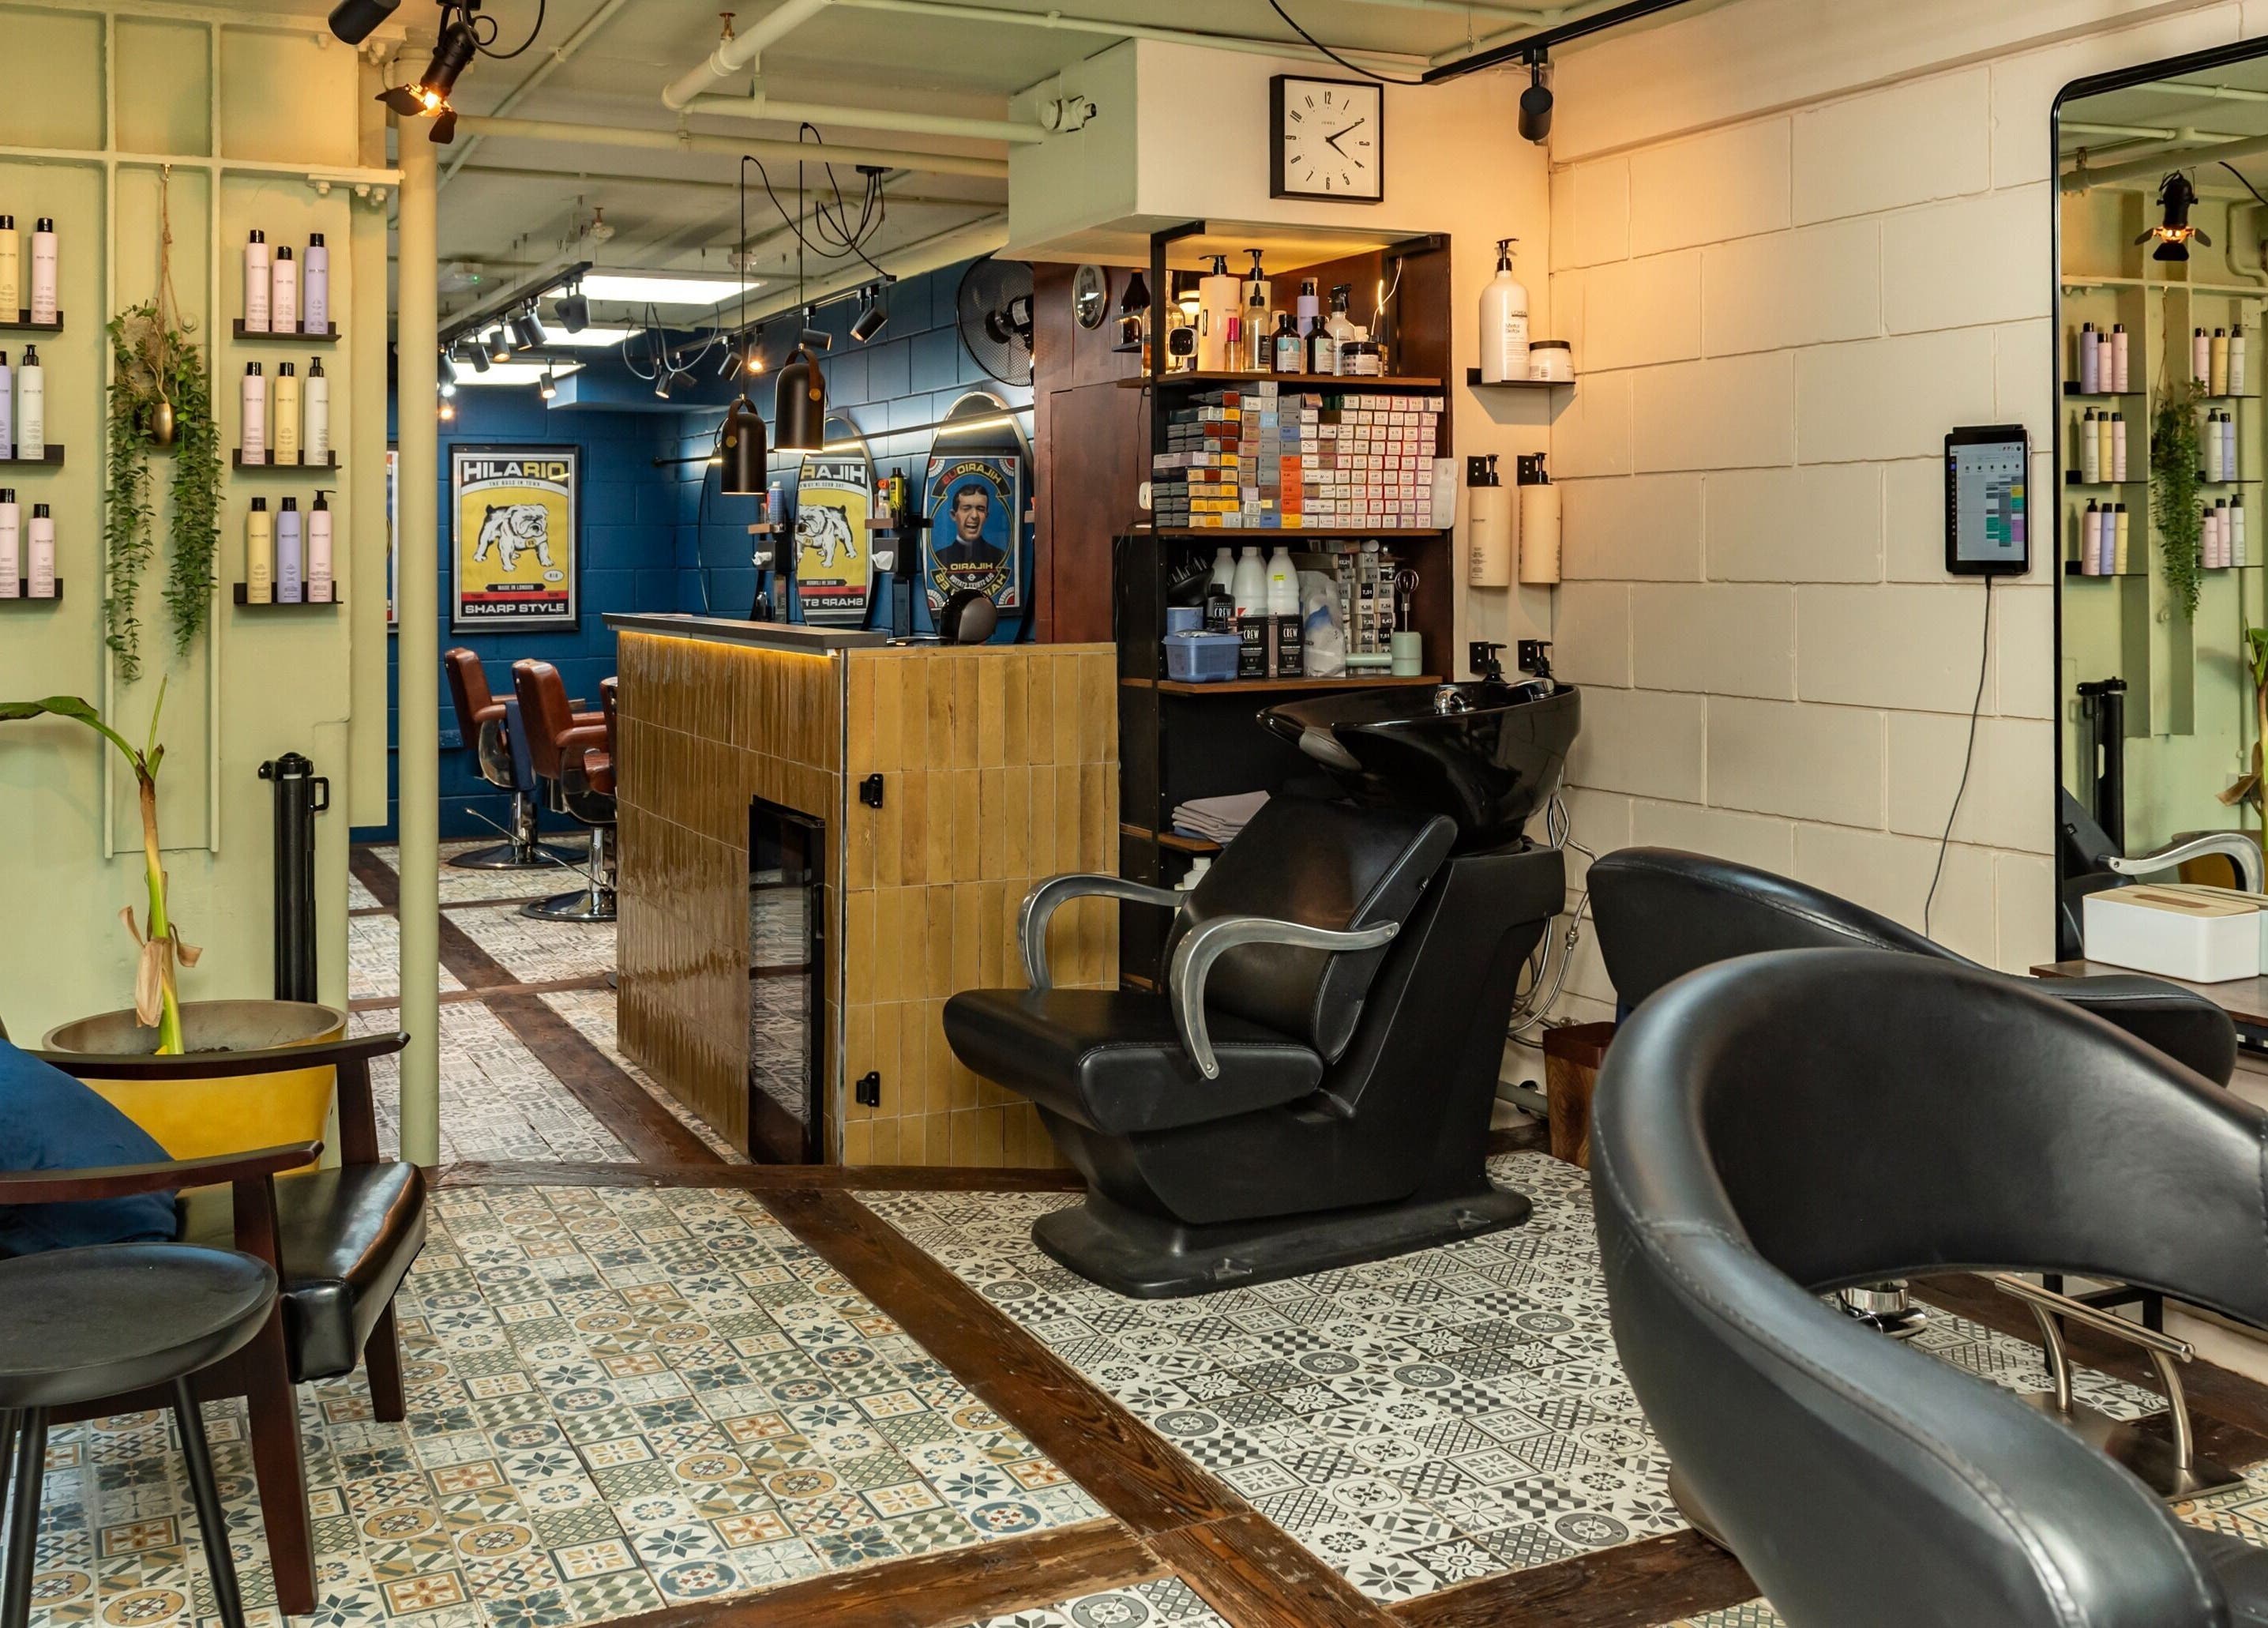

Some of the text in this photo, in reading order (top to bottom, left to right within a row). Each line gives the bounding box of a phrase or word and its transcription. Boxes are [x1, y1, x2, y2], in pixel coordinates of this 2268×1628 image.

[1305, 95, 1314, 109] 11
[1324, 91, 1331, 105] 12
[1343, 100, 1350, 111] 1
[1290, 110, 1302, 123] 10
[1290, 156, 1301, 164] 8
[1306, 171, 1314, 182] 7
[1342, 173, 1350, 186] 5
[1326, 177, 1331, 190] 6
[464, 462, 565, 482] HILARIO
[465, 603, 565, 614] SHARP STYLE
[1214, 607, 1232, 617] CREW
[1243, 630, 1260, 640] CREW
[1282, 628, 1298, 637] CREW
